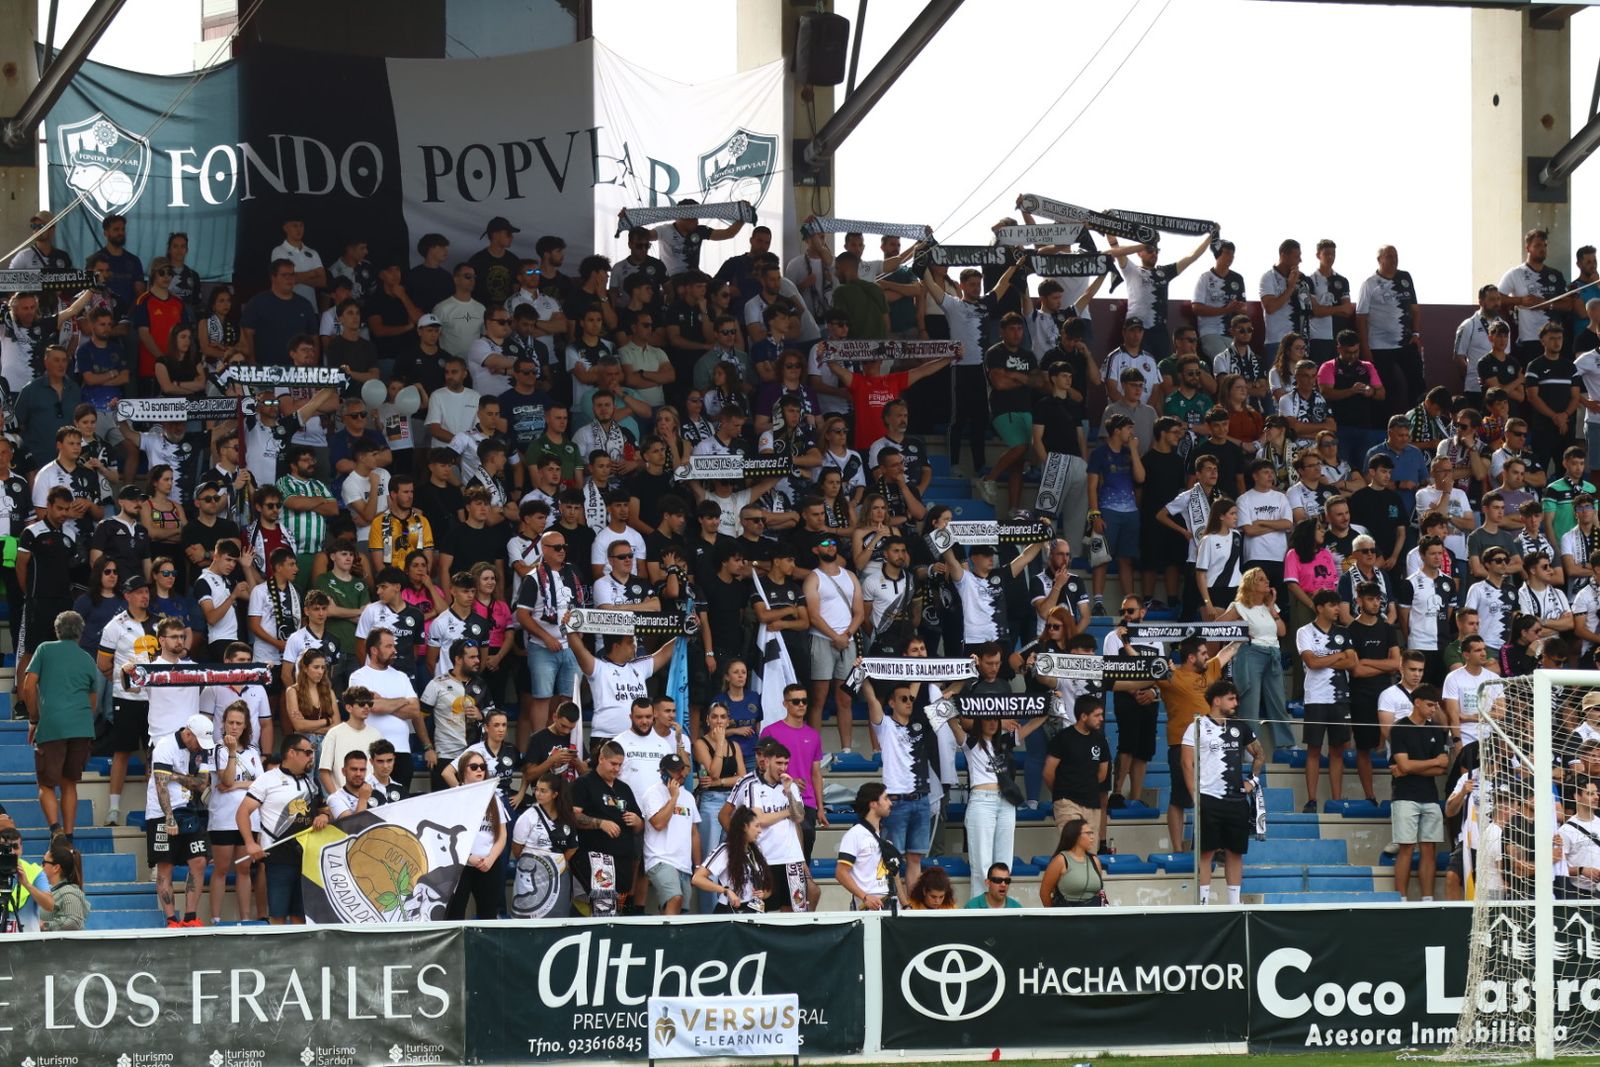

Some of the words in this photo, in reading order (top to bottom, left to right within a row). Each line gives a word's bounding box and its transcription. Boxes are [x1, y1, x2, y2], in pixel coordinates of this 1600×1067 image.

[80, 153, 105, 163] FONDO
[164, 134, 384, 207] FONDO
[40, 271, 77, 282] Salamanca
[230, 366, 339, 384] SALAMANCA
[740, 457, 778, 469] Salamanca
[995, 524, 1032, 536] Salamanca
[632, 614, 669, 627] Salamanca
[669, 615, 681, 627] C.F.
[867, 662, 904, 675] UNIONISTAS
[905, 664, 915, 675] DE
[916, 664, 955, 676] SALAMANCA
[956, 663, 966, 675] CF
[1057, 657, 1092, 670] UNIONISTAS
[1100, 659, 1136, 672] Salamanca
[1136, 660, 1148, 672] C.F.
[960, 696, 1046, 711] UNIONISTAS
[328, 853, 343, 869] LA
[330, 873, 361, 913] GRADA
[1019, 966, 1128, 994] HACHA
[1136, 963, 1245, 992] MOTOR
[1256, 947, 1406, 1019] Coco
[45, 972, 160, 1030] LOS
[192, 963, 450, 1025] FRAILES
[573, 1012, 648, 1030] PREVENC
[681, 1004, 796, 1032] VERSUS
[694, 1033, 784, 1047] E-LEARNING
[1304, 1023, 1401, 1046] Asesora
[318, 1045, 357, 1056] turismo
[406, 1042, 445, 1053] turismo
[528, 1038, 565, 1055] Tfno.
[568, 1036, 642, 1054] 923616845
[39, 1056, 79, 1065] turismo
[135, 1052, 174, 1062] turismo
[227, 1049, 266, 1058] turismo
